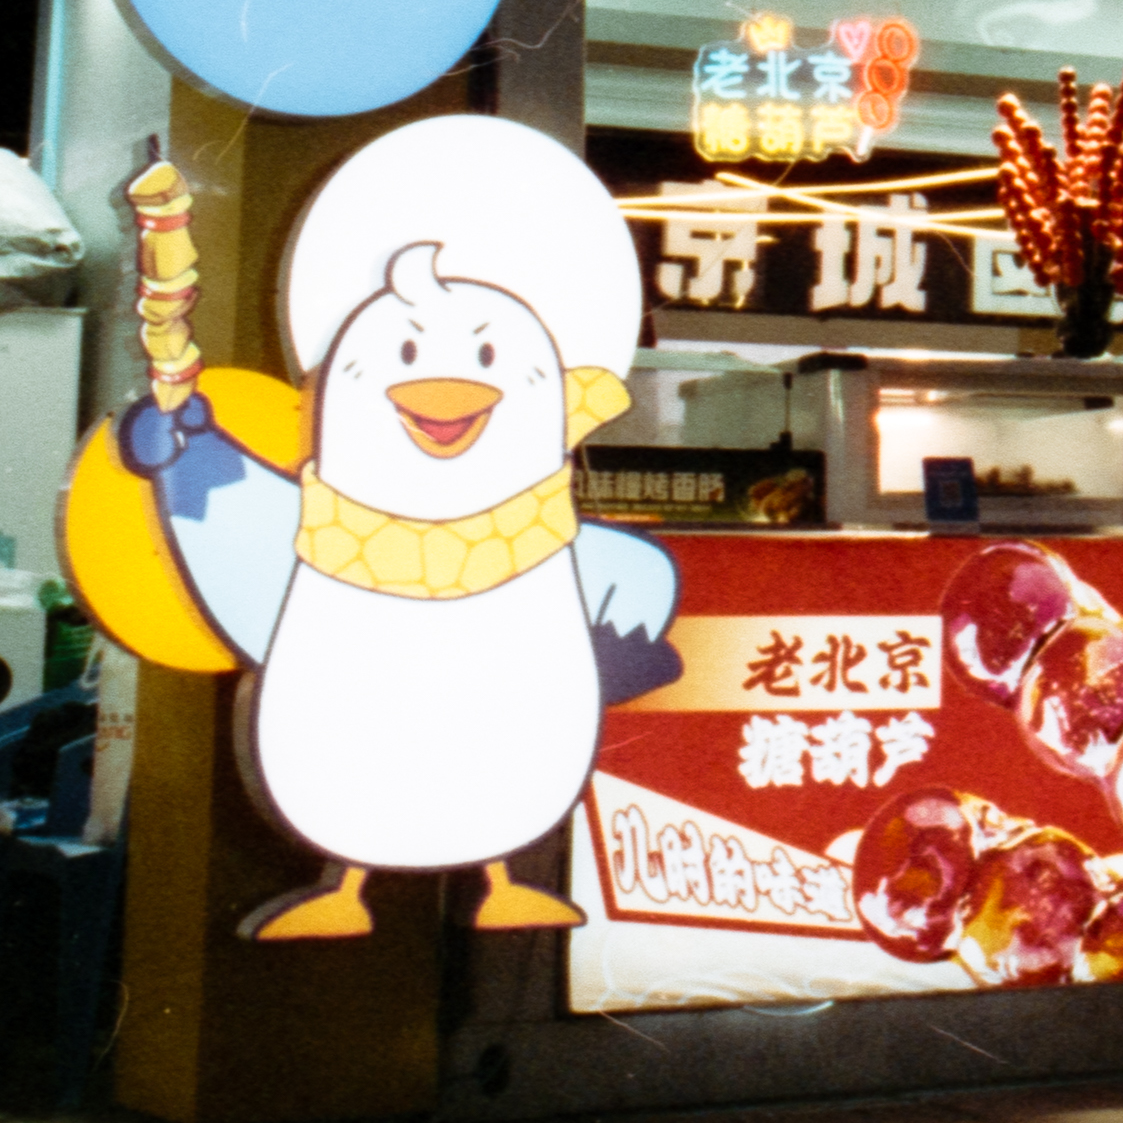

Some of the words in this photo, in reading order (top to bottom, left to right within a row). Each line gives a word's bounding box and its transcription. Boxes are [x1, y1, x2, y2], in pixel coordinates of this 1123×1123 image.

[701, 49, 853, 103] 老北京
[743, 630, 931, 697] 老北京
[738, 710, 935, 789] 糖葫芦
